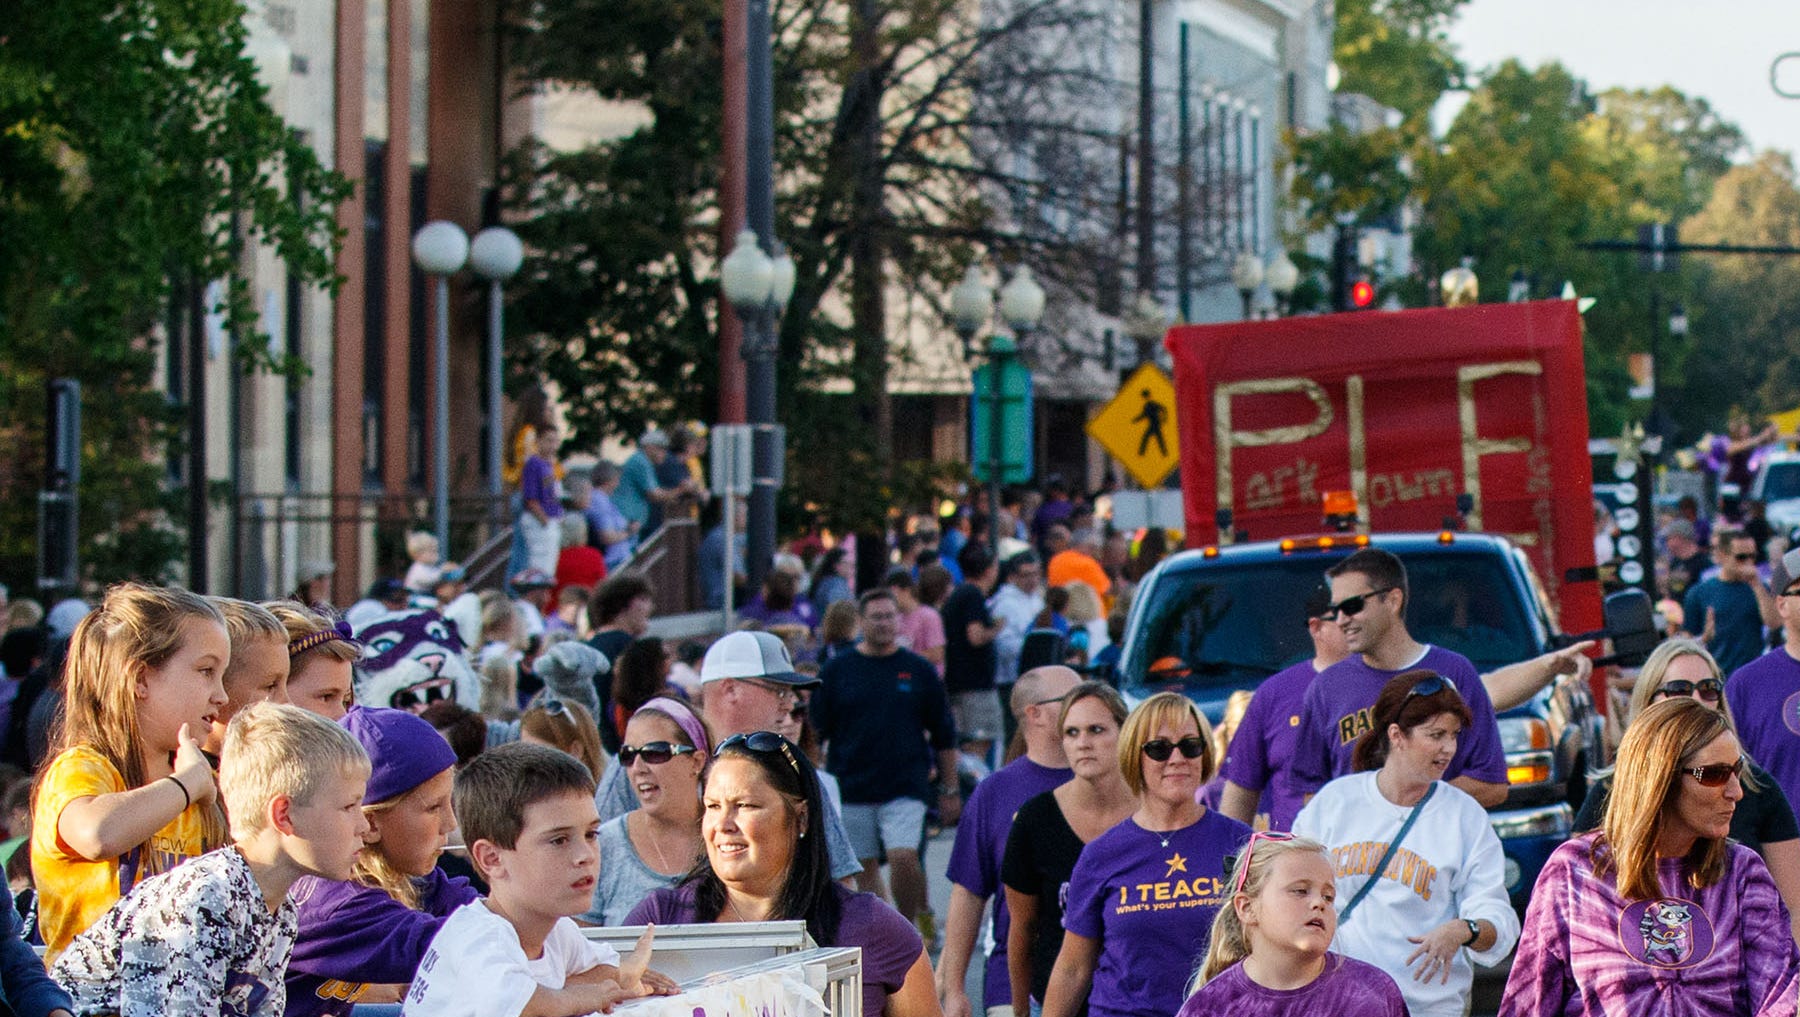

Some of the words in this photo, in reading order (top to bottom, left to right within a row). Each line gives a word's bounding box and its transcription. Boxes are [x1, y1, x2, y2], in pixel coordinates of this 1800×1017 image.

[1119, 886, 1128, 905] I
[1116, 903, 1150, 914] What's
[1152, 902, 1177, 912] your
[1179, 897, 1222, 908] superpo
